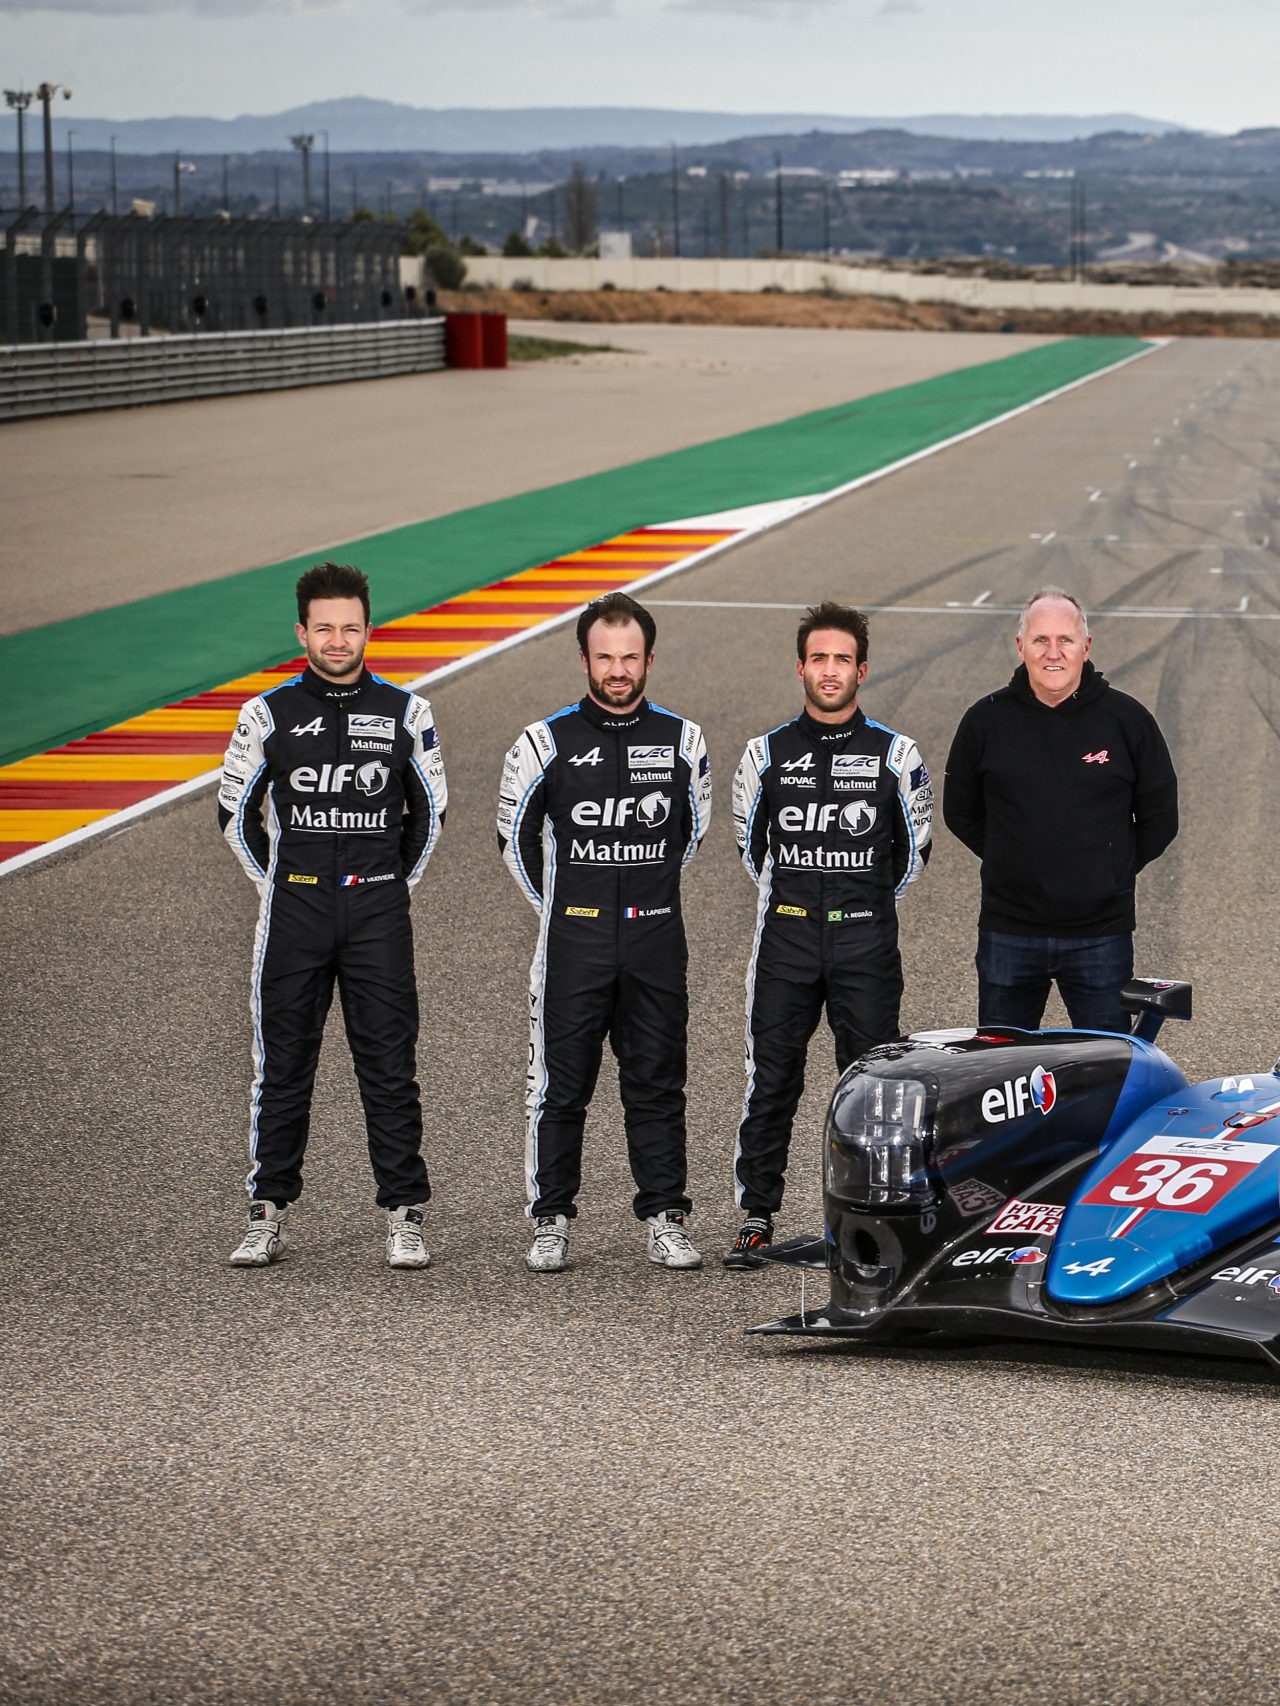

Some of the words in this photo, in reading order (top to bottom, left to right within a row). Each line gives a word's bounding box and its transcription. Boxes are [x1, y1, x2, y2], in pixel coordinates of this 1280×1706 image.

[325, 688, 361, 697] ALPIN
[820, 730, 854, 741] ALPIN
[232, 740, 251, 752] mut
[351, 740, 393, 752] Matmut
[834, 757, 878, 767] WEC
[289, 764, 355, 793] elf
[630, 771, 672, 781] Matmut
[780, 777, 816, 785] NOVAC
[833, 780, 877, 789] Matmut
[571, 797, 636, 827] elf
[911, 803, 934, 815] Matm
[290, 805, 387, 829] Matmut
[778, 803, 839, 832] elf
[914, 816, 933, 826] NOV
[570, 838, 667, 861] Matmut
[778, 843, 875, 868] Matmut
[646, 907, 671, 916] LAPIERRE
[981, 1075, 1029, 1124] elf
[1109, 1159, 1228, 1206] 36
[952, 1248, 1015, 1267] elf
[1211, 1266, 1278, 1285] elf
